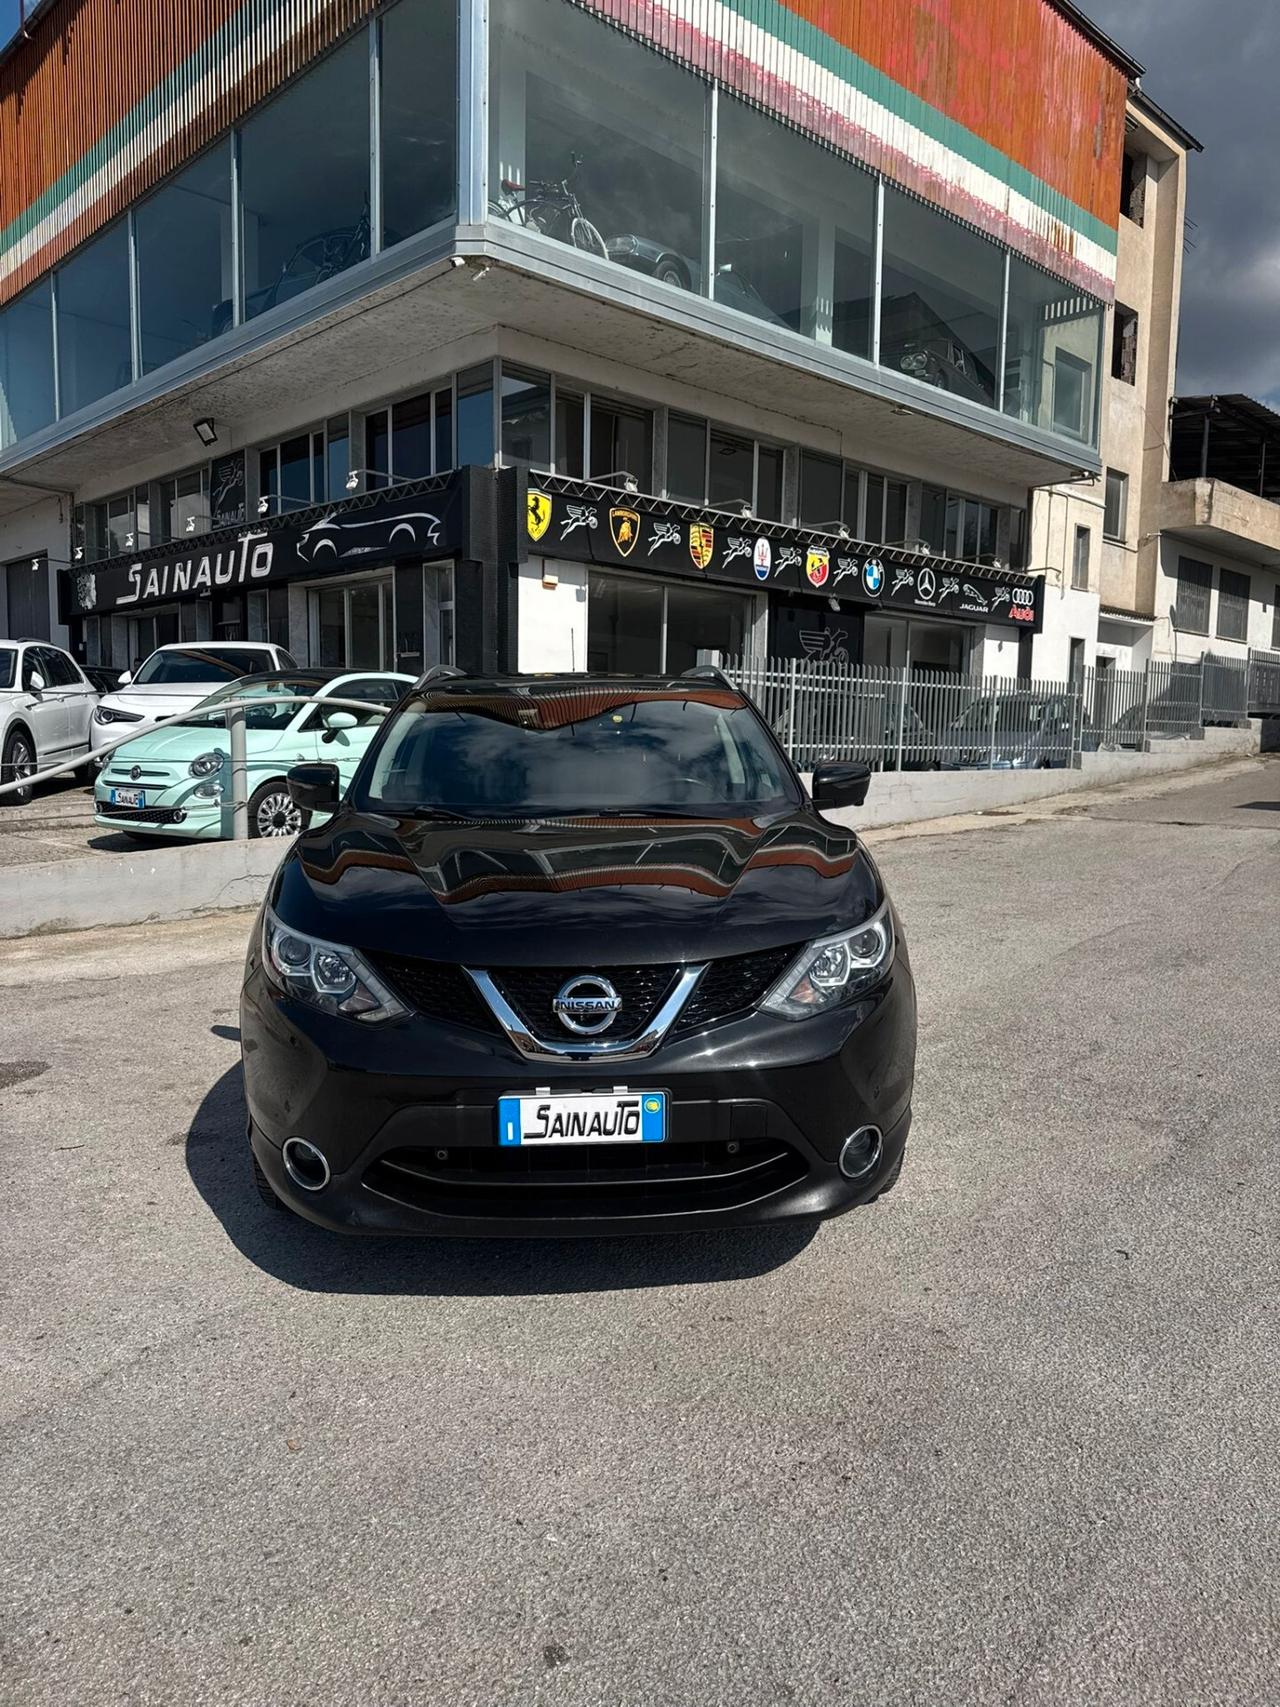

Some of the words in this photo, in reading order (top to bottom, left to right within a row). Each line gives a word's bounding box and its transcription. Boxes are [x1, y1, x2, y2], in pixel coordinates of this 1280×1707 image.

[116, 532, 274, 605] SAINAUTO
[959, 603, 989, 613] JAGUAR
[1008, 604, 1035, 622] Audi
[560, 1000, 615, 1010] NISSAN
[523, 1100, 641, 1139] SAINAUTO
